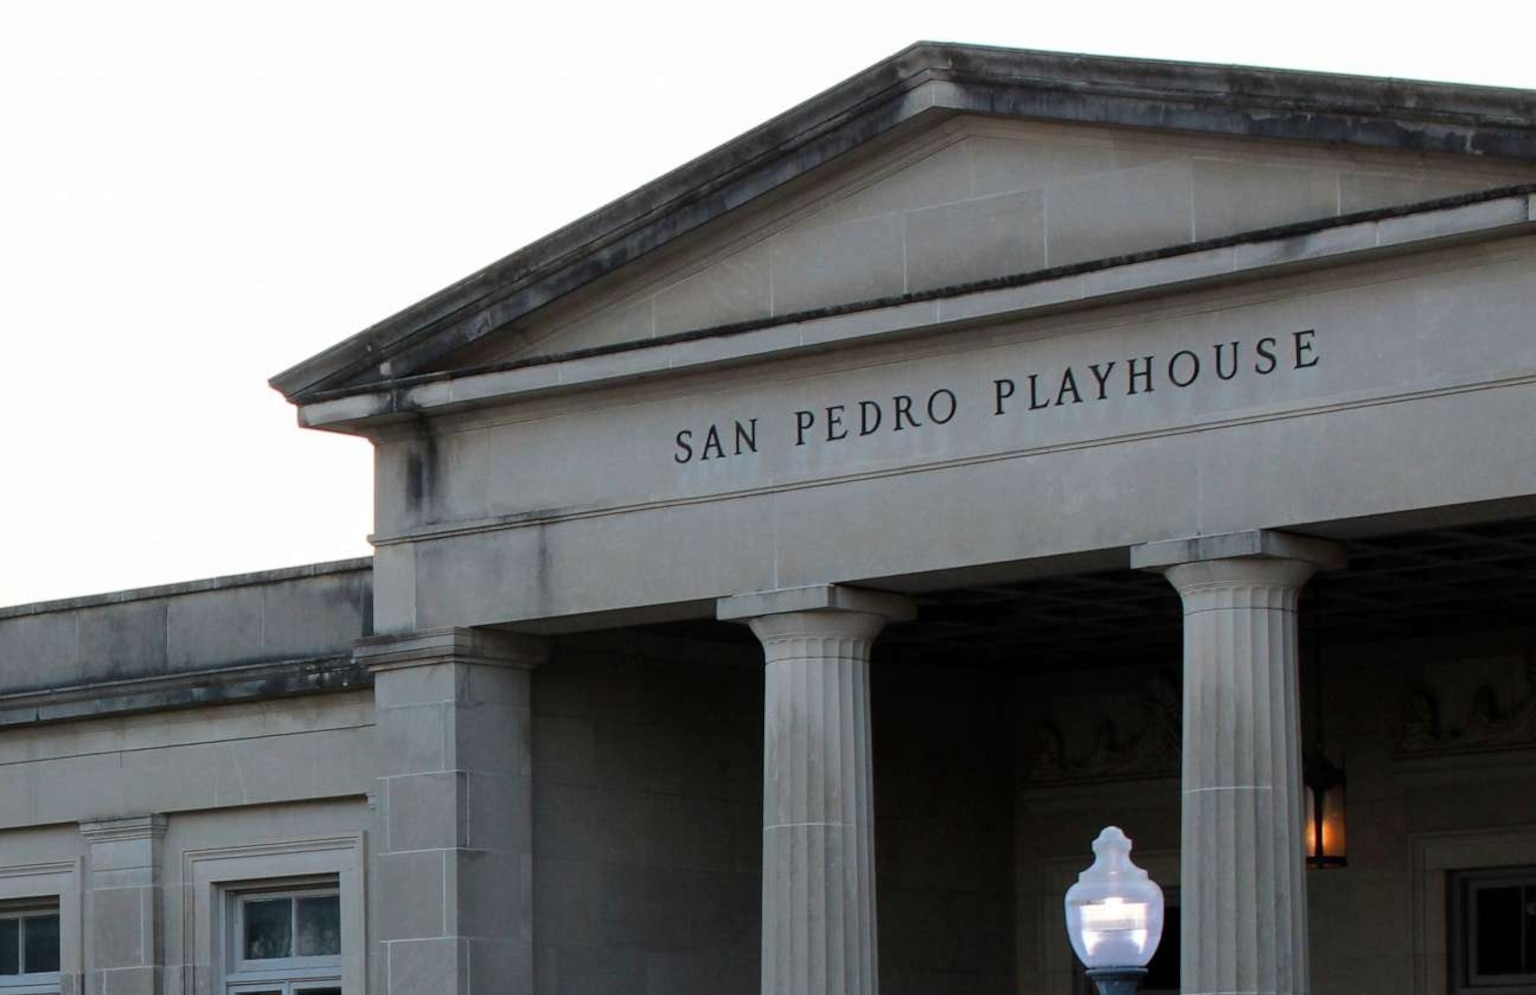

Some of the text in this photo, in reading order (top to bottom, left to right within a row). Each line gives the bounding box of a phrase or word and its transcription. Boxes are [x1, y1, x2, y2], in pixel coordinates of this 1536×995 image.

[674, 329, 1320, 464] SAN PEDRO PLAYHOUSE
